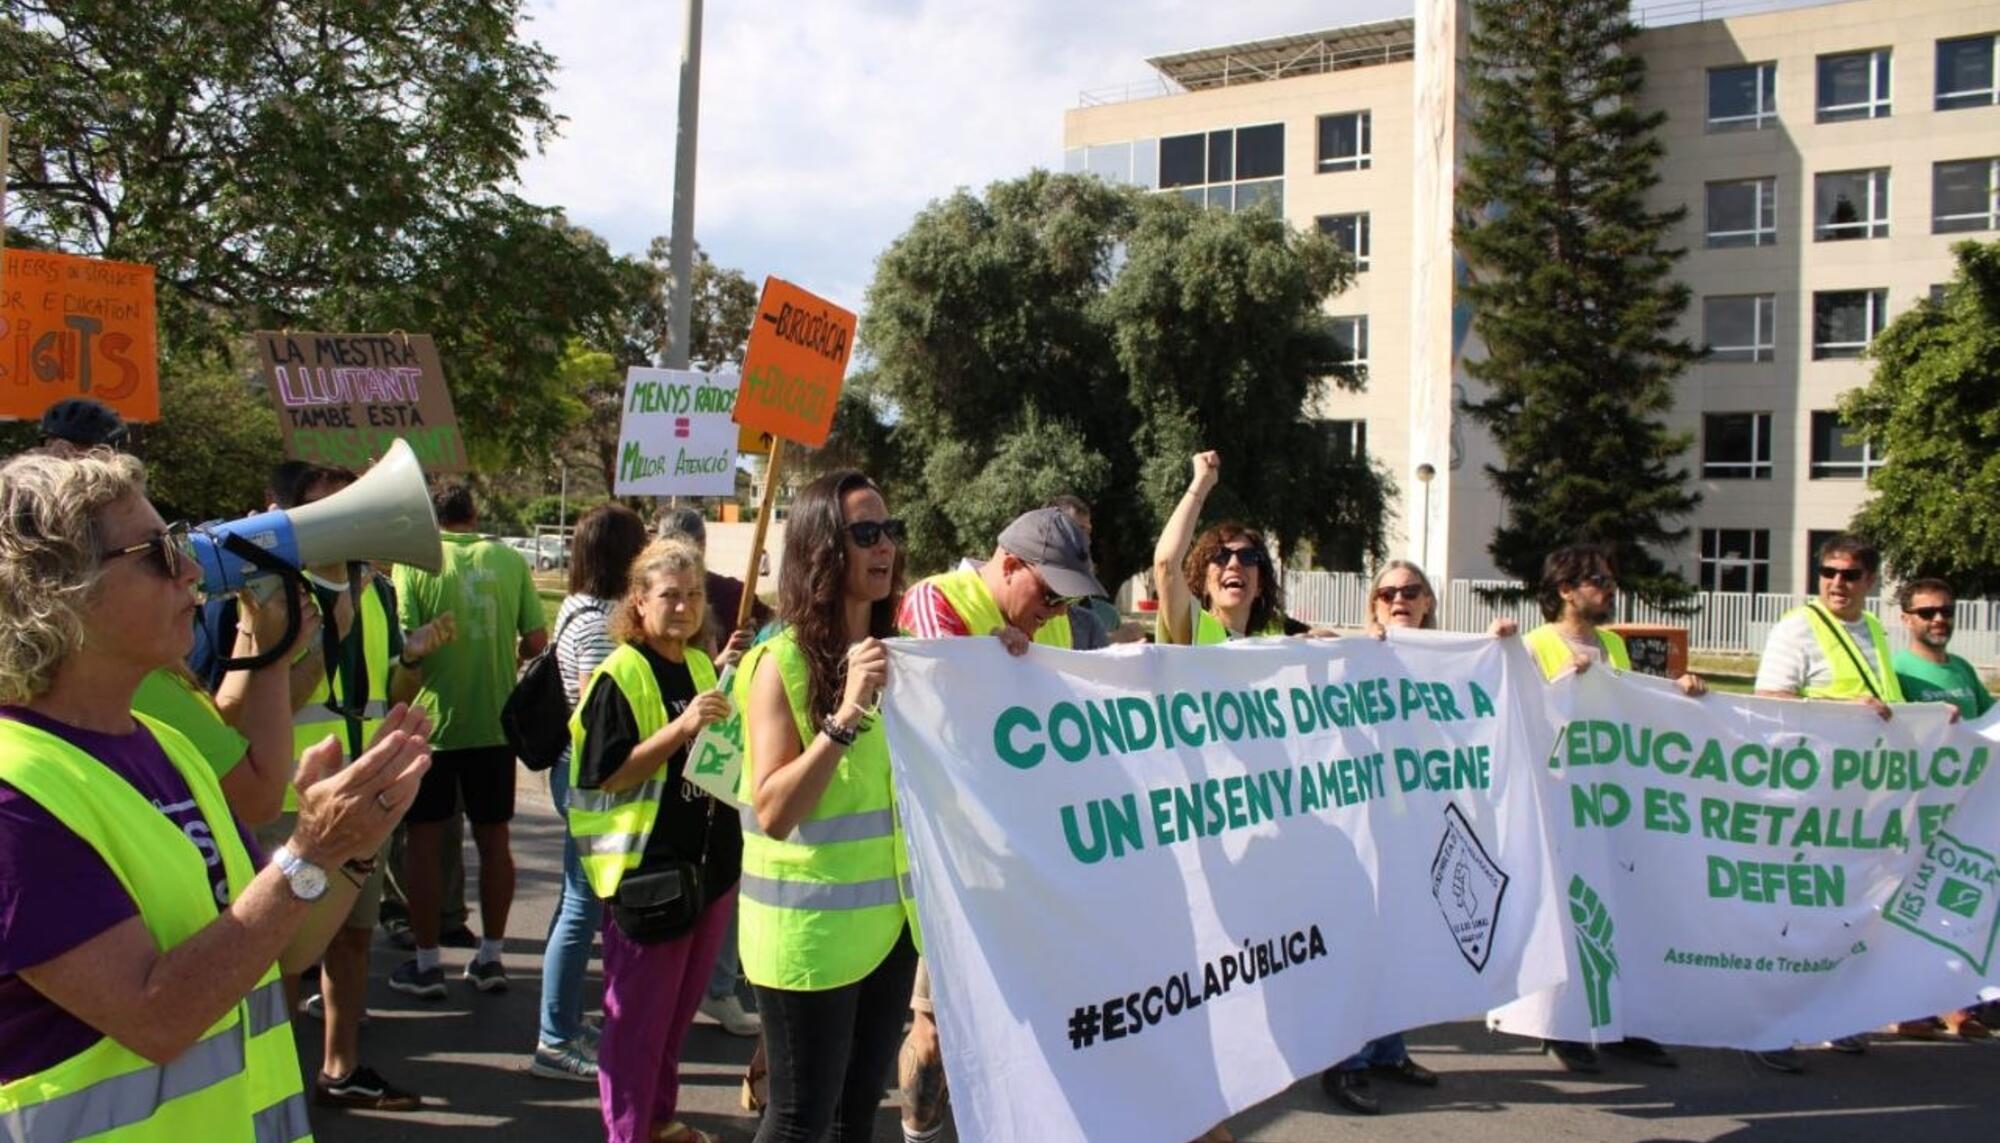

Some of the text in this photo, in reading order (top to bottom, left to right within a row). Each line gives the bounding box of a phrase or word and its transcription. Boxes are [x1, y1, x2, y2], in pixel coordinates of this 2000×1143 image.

[269, 337, 420, 366] LA MESTRA
[275, 365, 422, 406] LLUITANT
[629, 381, 692, 414] MENYS
[288, 404, 355, 427] TAMBÉ
[993, 677, 1496, 771] CONDICIONS DIGNES PER A
[1060, 791, 1145, 865] UN
[1149, 752, 1386, 846] ENSENYAMENT
[1570, 782, 1632, 829] NO
[1643, 786, 1693, 835] ES
[1706, 854, 1847, 907] DEFÉN
[1900, 892, 1926, 921] IES
[1913, 862, 1936, 891] LAS
[1664, 947, 1752, 970] Assemblea
[1755, 956, 1774, 972] de
[1068, 924, 1327, 1050] #ESCOLAPÚBLICA
